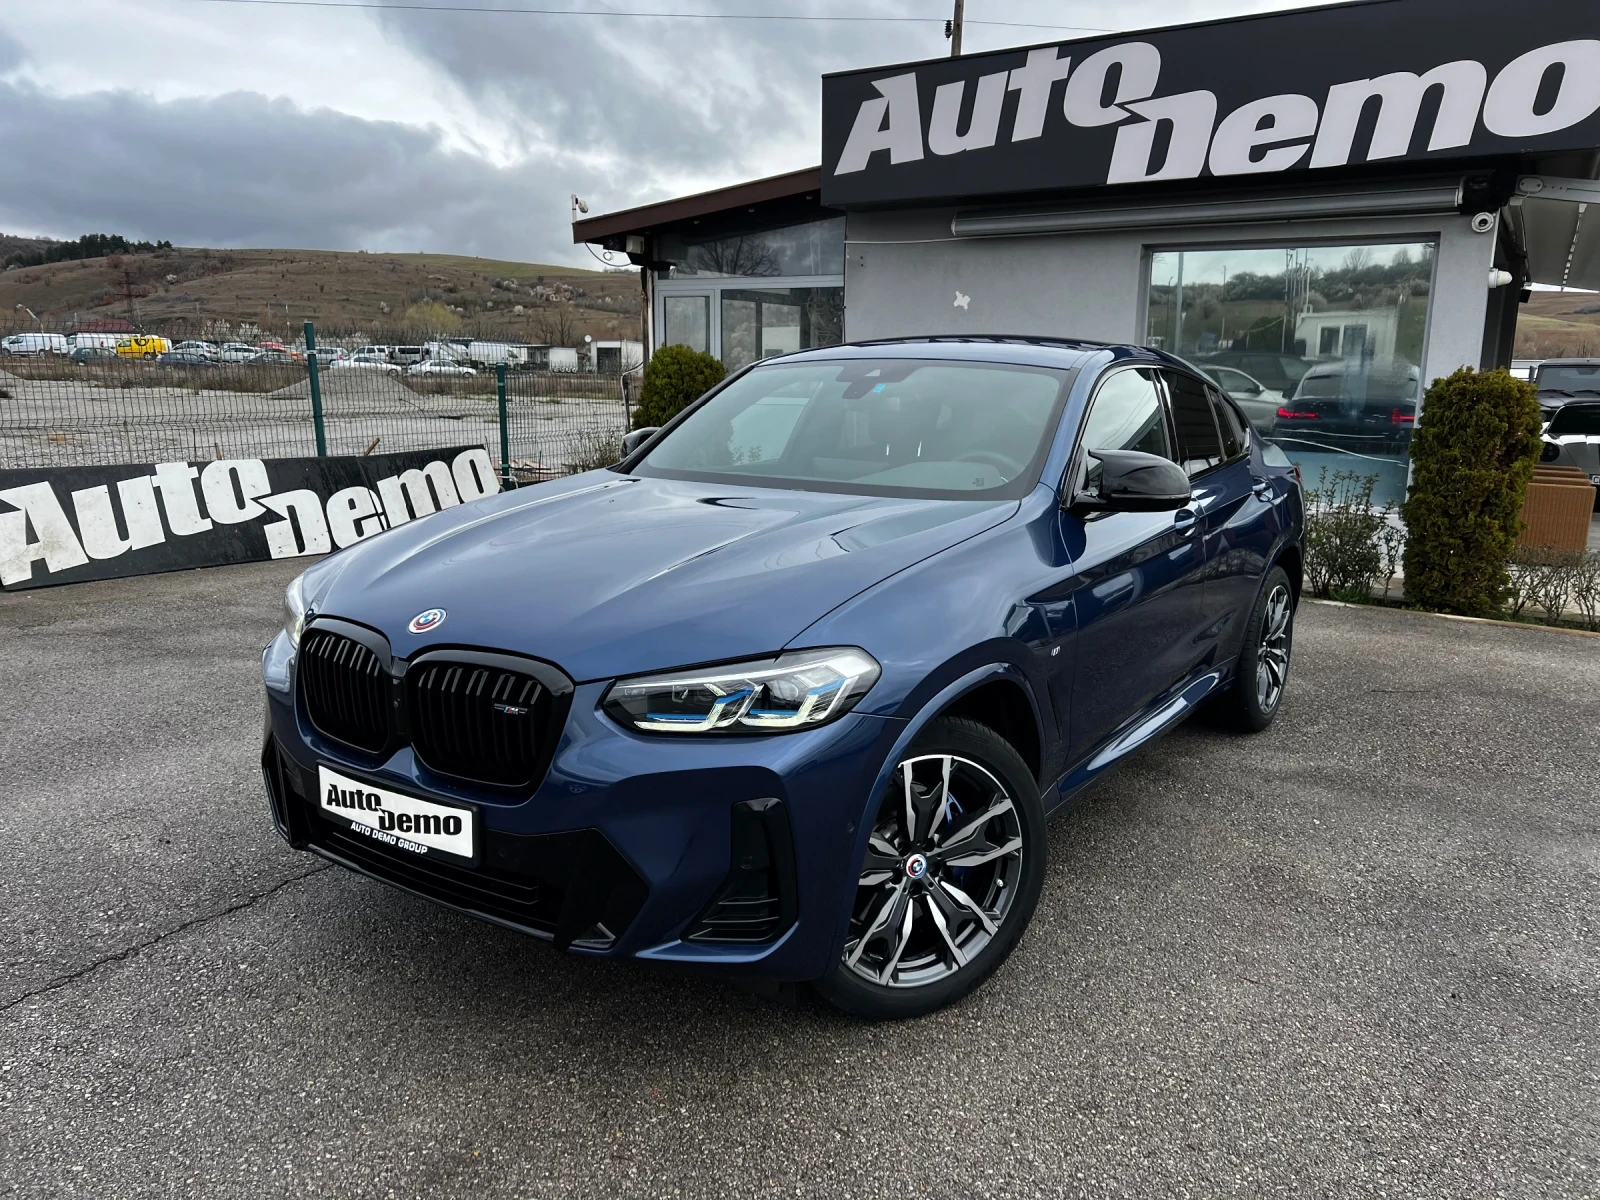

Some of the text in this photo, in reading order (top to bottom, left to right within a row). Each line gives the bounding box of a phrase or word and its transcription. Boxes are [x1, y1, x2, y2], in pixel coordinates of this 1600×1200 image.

[833, 39, 1600, 185] Auto Demo
[0, 448, 501, 586] Auto Demo
[326, 783, 463, 836] Auto Demo
[350, 821, 429, 855] AUTO DEMO GROUP
